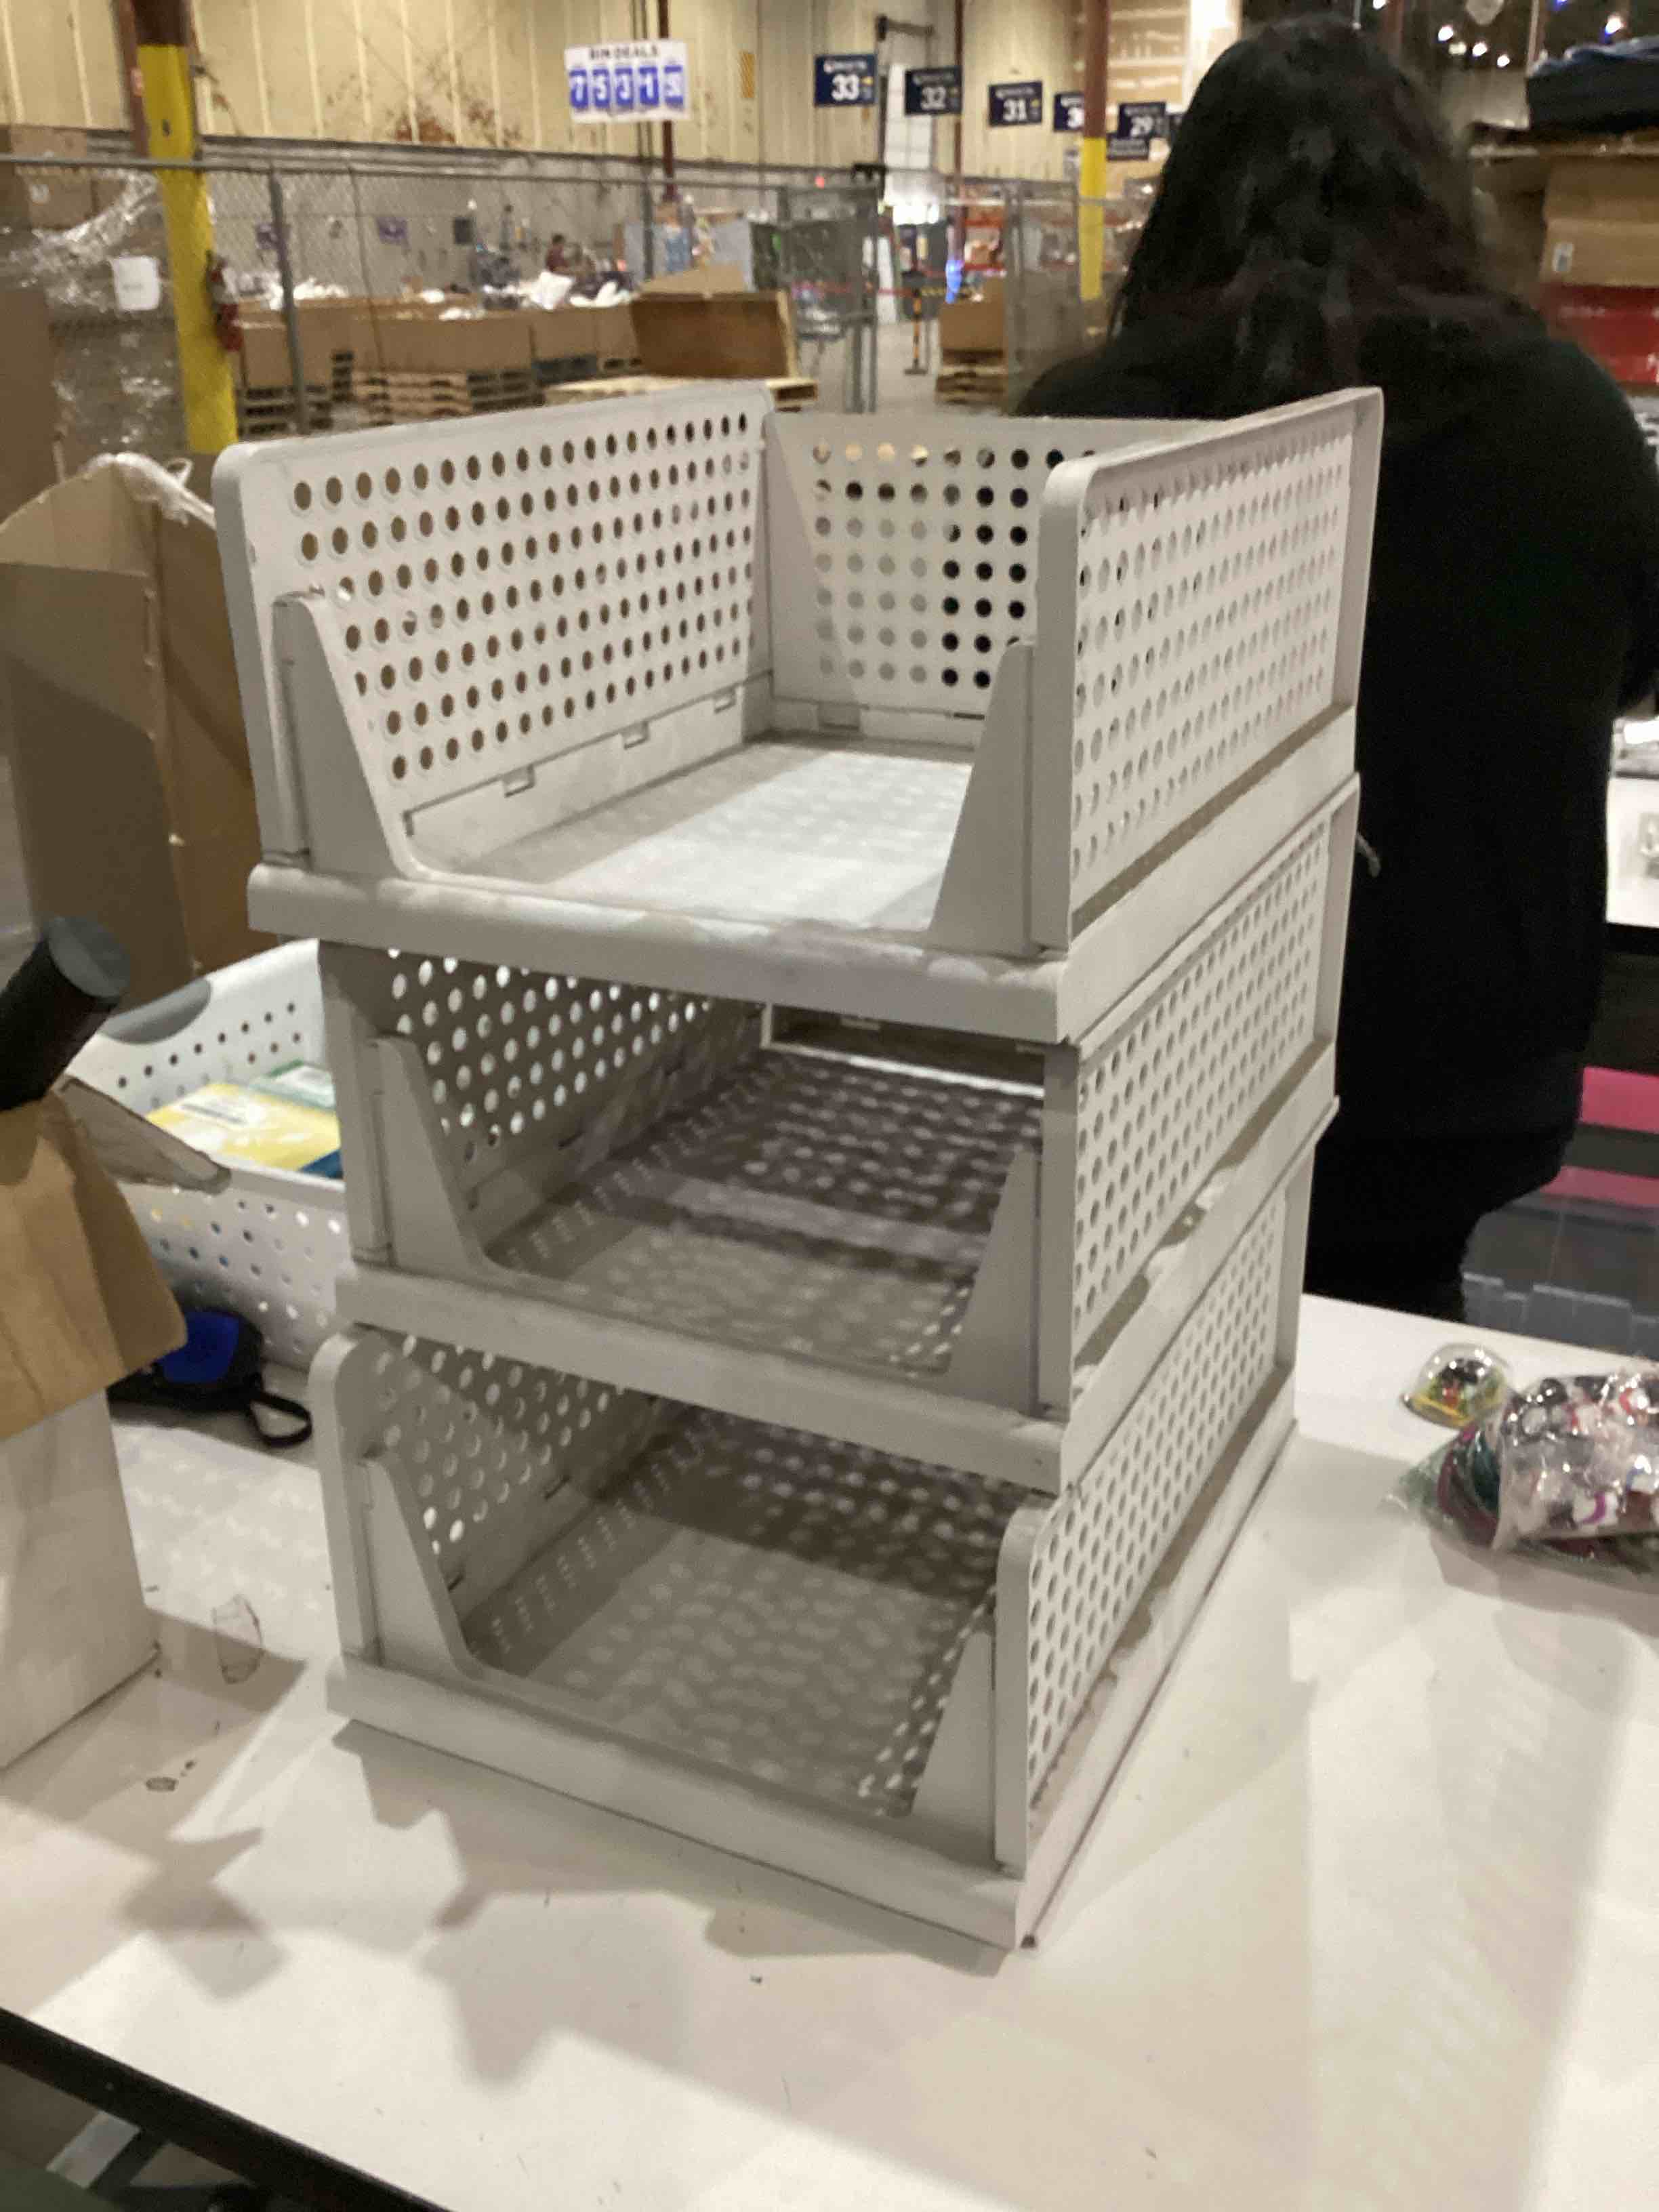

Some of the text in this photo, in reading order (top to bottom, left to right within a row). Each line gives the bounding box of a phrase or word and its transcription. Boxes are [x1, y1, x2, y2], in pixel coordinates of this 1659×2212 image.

[590, 48, 610, 60] BIN
[831, 73, 860, 101] 33
[920, 85, 946, 110] 32
[1002, 99, 1027, 122] 31
